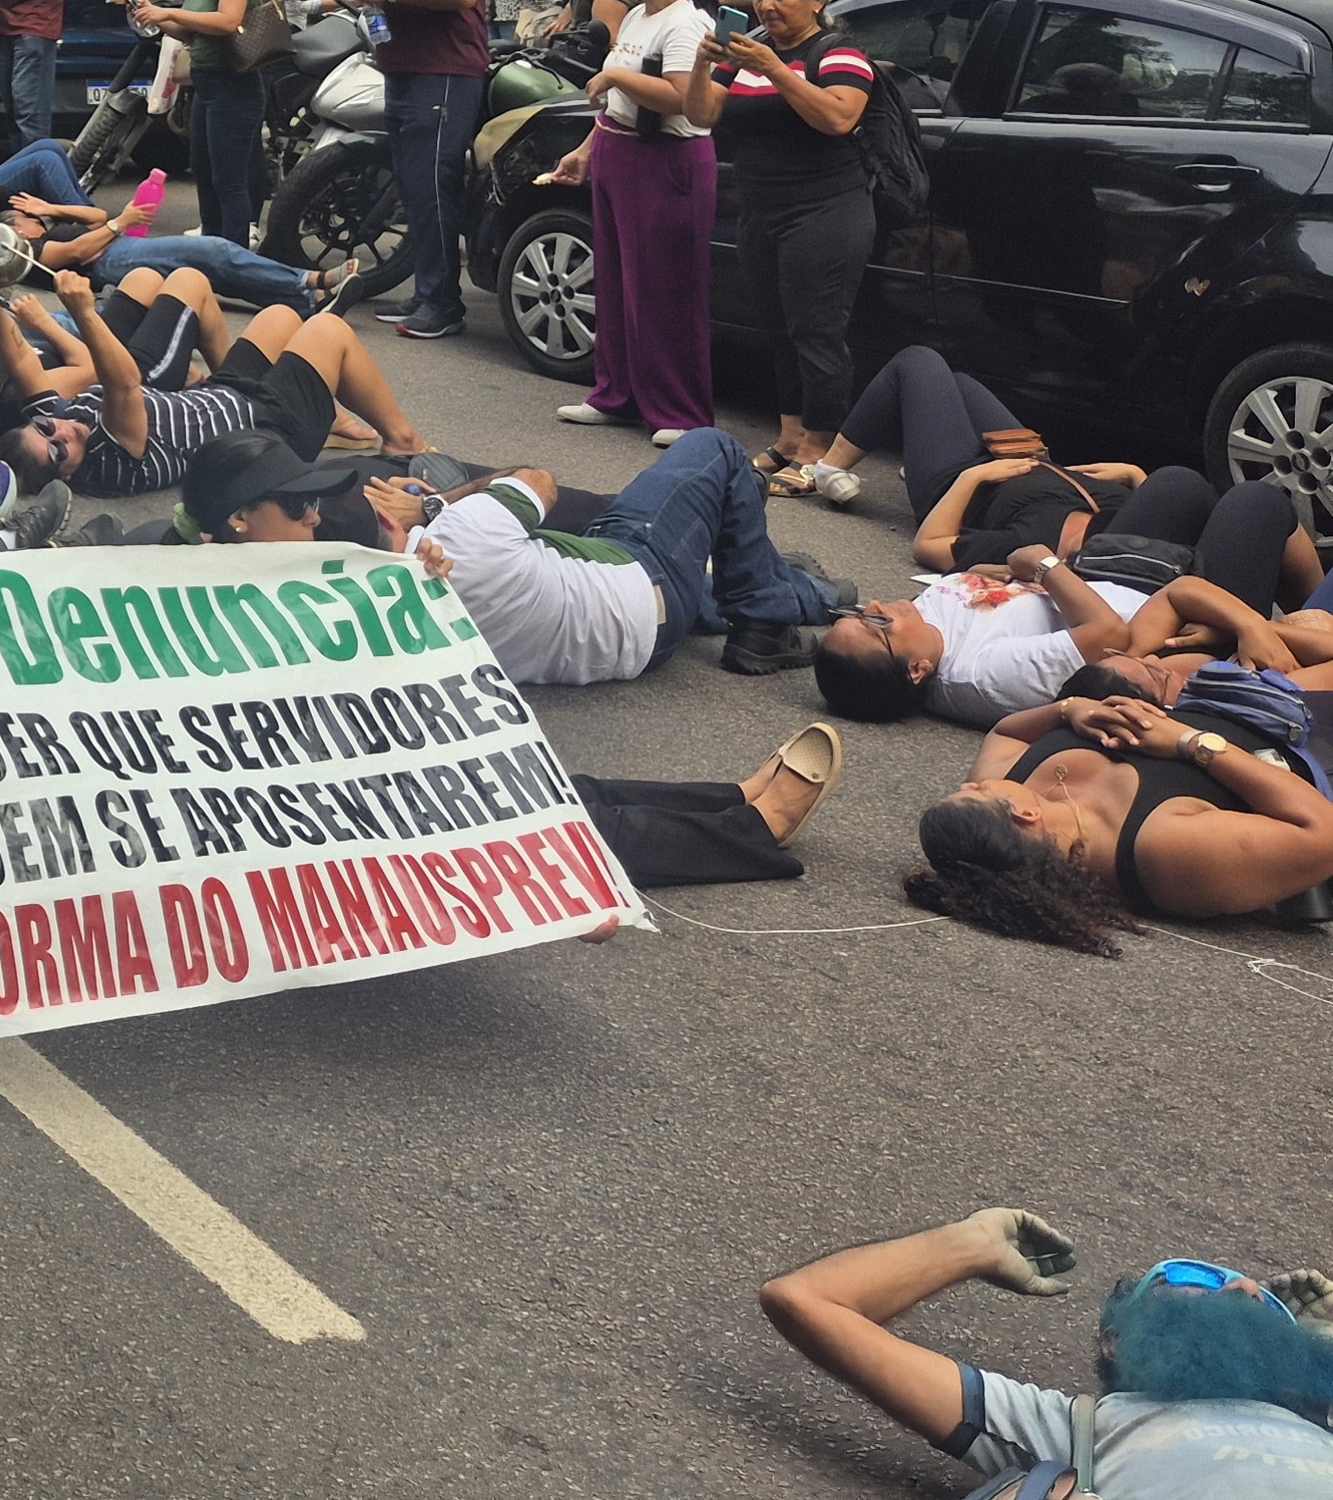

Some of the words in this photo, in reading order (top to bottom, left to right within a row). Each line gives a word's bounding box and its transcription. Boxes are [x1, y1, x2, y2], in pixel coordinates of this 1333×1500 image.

[77, 705, 189, 781] QUE
[181, 664, 530, 772] SERVIDORES
[96, 788, 180, 868] SE
[168, 740, 579, 855] APOSENTAREM!
[164, 876, 251, 988] DO
[246, 821, 631, 972] MANAUSPREV!
